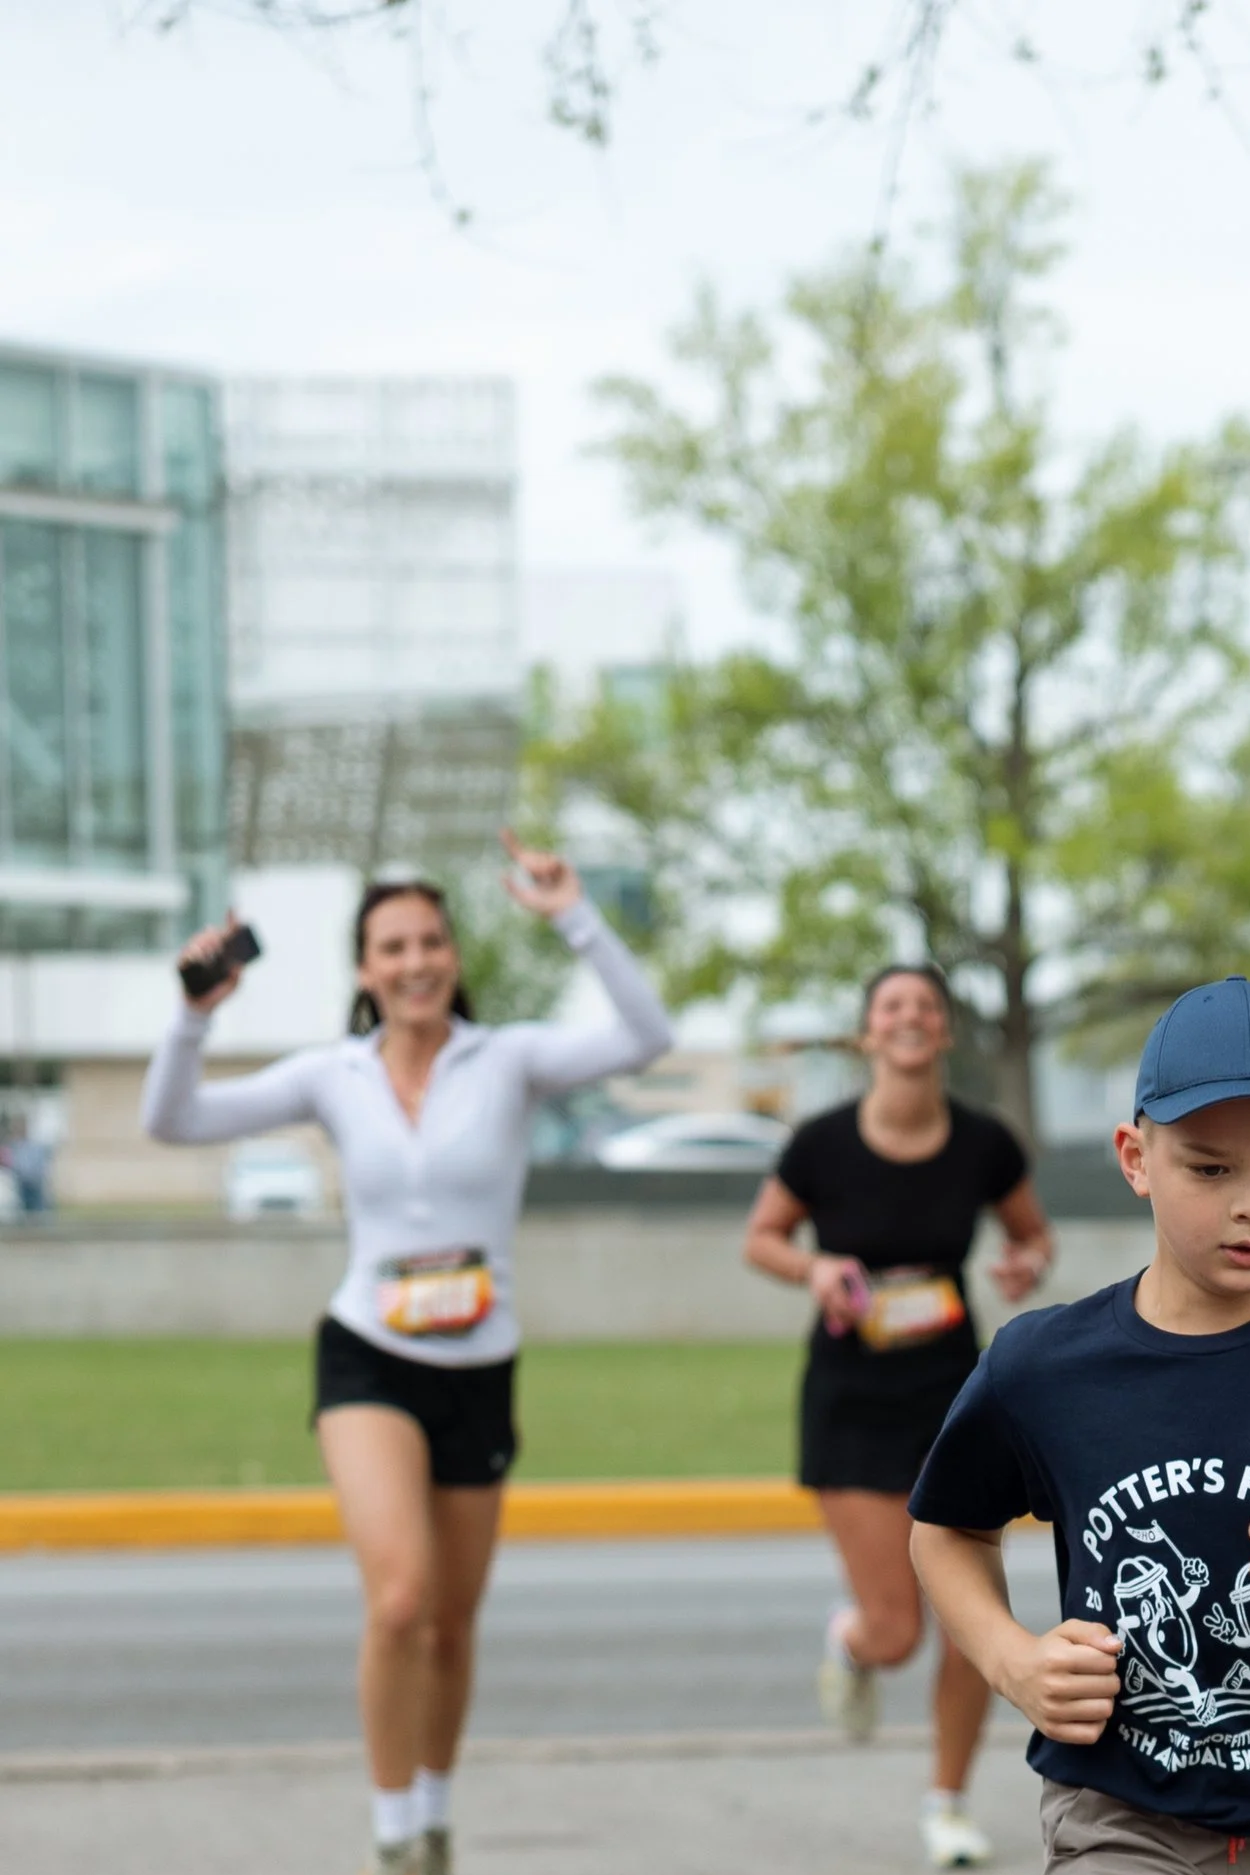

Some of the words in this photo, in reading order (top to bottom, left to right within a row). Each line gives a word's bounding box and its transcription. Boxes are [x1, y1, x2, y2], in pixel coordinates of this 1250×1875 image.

[1082, 1458, 1225, 1563] POTTER'S
[1085, 1586, 1103, 1612] 20
[1118, 1723, 1158, 1756] 4TH
